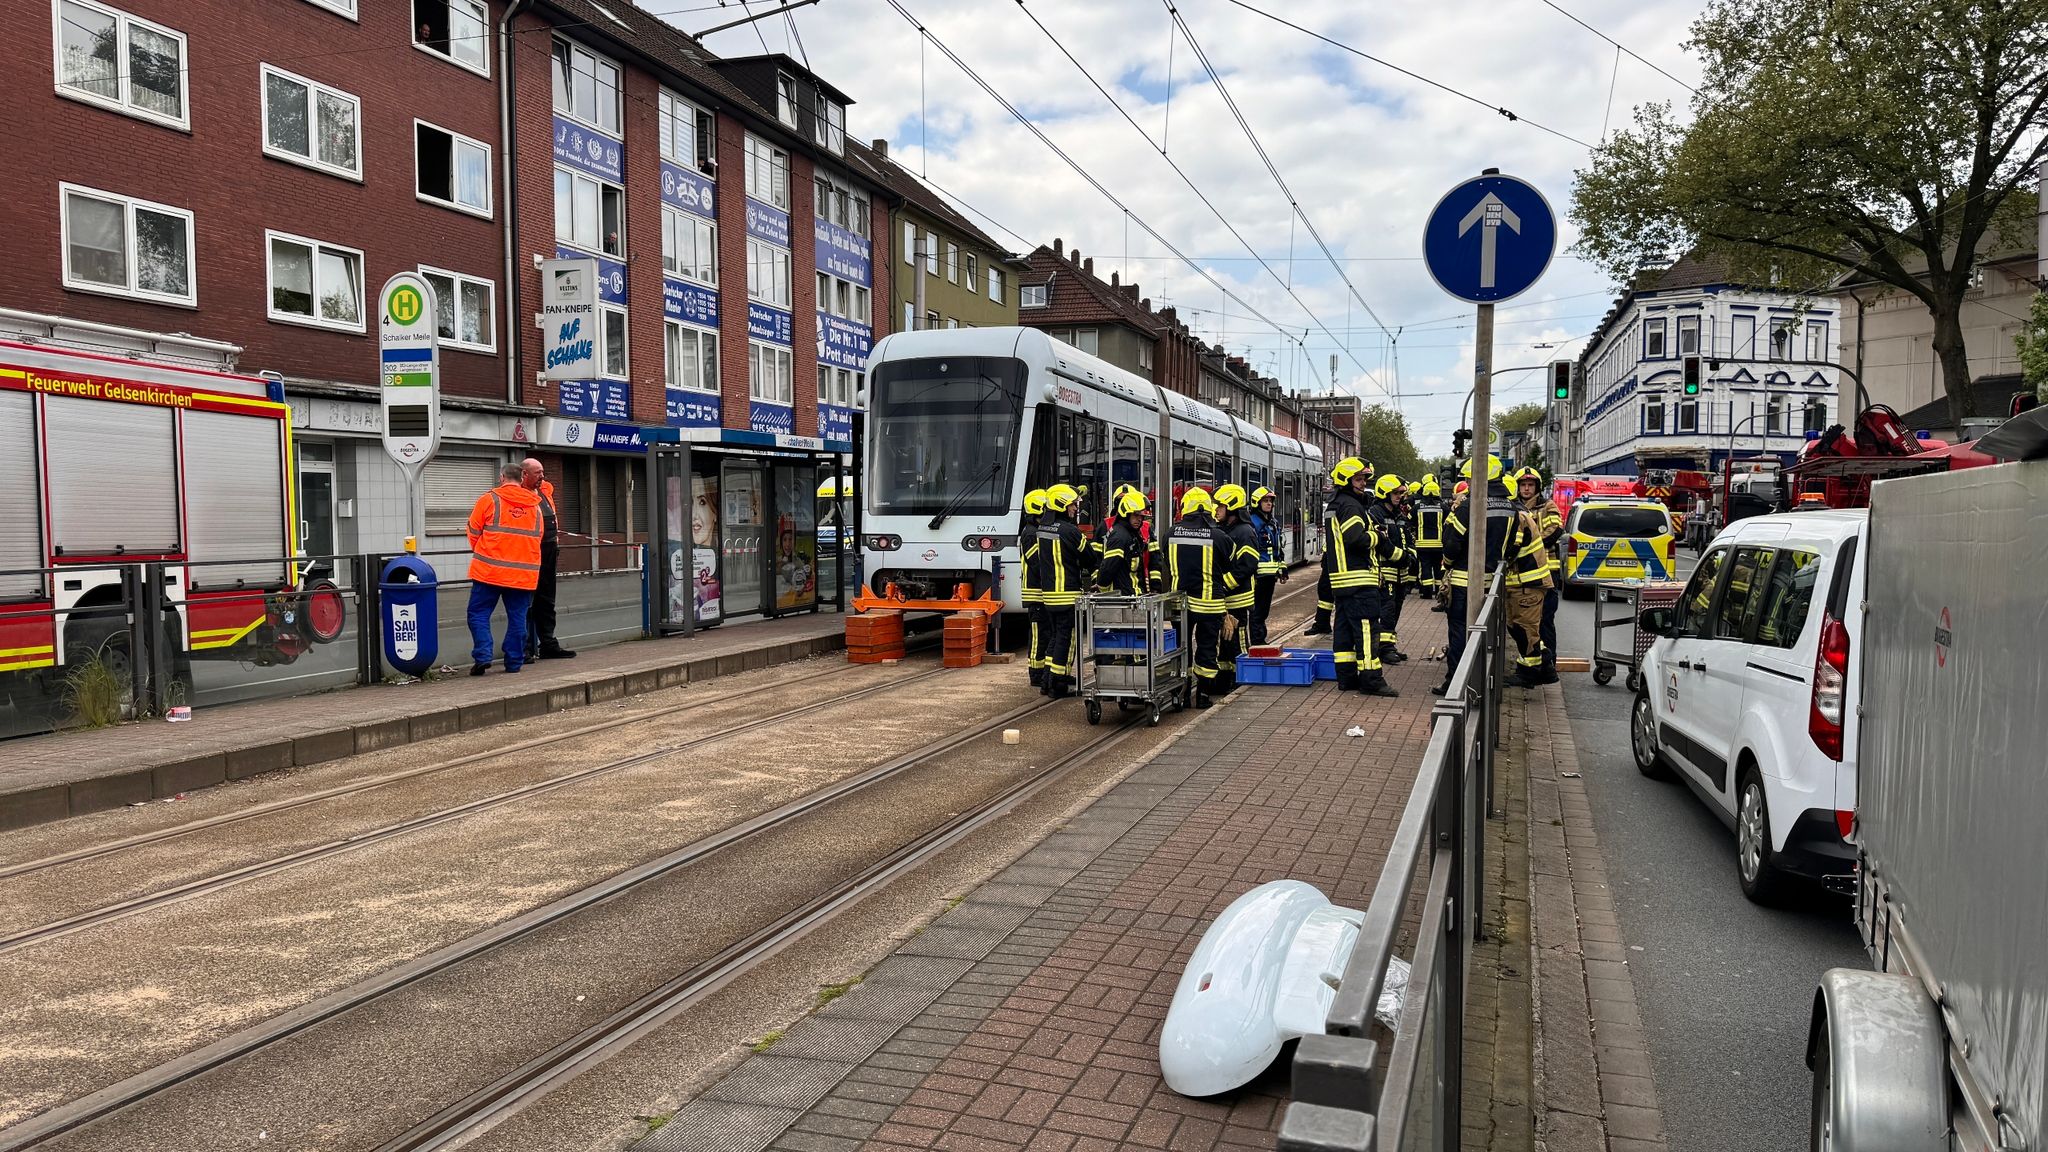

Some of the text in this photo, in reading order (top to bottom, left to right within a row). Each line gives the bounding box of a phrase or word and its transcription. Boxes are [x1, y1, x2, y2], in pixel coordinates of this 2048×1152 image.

[546, 304, 592, 314] FAN-KNEIPE
[383, 315, 390, 326] 4
[559, 318, 580, 344] AUF
[830, 328, 841, 344] Die
[860, 337, 868, 352] im
[547, 339, 592, 369] SCHALKE
[826, 346, 841, 362] Pott
[843, 351, 856, 366] sind
[26, 372, 192, 407] Feuerwehr Gelsenkirchen
[1059, 386, 1082, 406] BOGESTRA
[598, 434, 629, 444] FAN-KNEIPE
[395, 620, 415, 632] SAU
[396, 632, 416, 641] BER!
